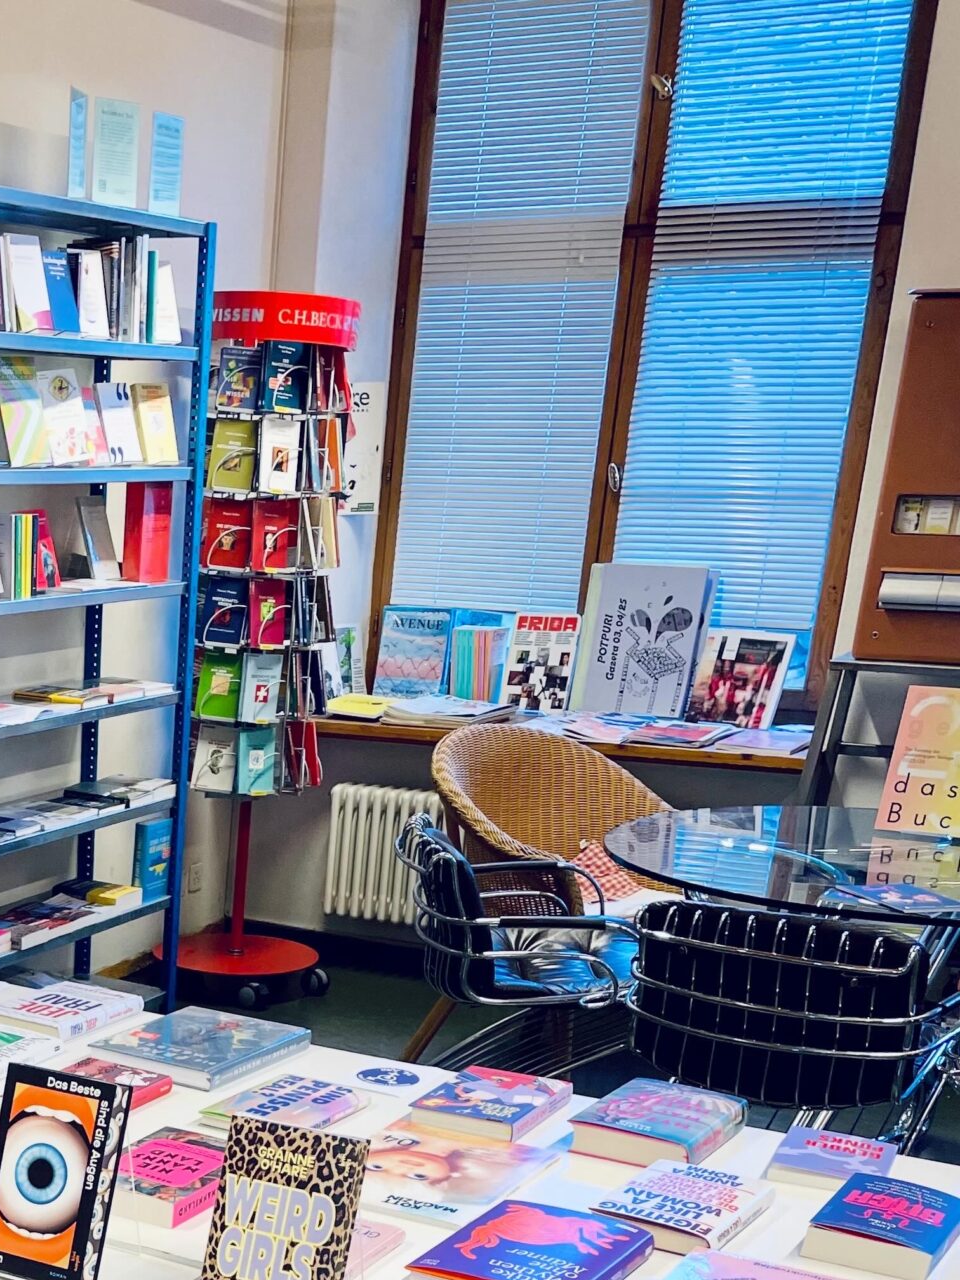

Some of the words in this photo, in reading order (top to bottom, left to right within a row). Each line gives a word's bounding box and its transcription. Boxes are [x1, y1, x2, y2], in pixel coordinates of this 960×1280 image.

[392, 616, 444, 632] AVENUE
[517, 614, 578, 632] FRIDA
[597, 613, 614, 664] POTPURI
[894, 772, 958, 798] das
[16, 1001, 81, 1018] JEDE
[34, 994, 103, 1012] FRAU
[47, 1076, 69, 1089] Das
[70, 1080, 102, 1098] Beste
[311, 1086, 354, 1105] SIND
[245, 1079, 334, 1117] PENISSE
[98, 1099, 110, 1128] sind
[94, 1127, 106, 1149] die
[819, 1134, 884, 1153] PUNKS
[804, 1139, 882, 1159] GENDER
[85, 1149, 103, 1191] Augen
[260, 1158, 308, 1179] O'HARE
[671, 1167, 744, 1188] ANDREA
[224, 1173, 336, 1246] WEIRD
[386, 1194, 458, 1214] MAGAZIN
[623, 1186, 723, 1218] WOMAN
[631, 1196, 648, 1205] A
[598, 1201, 712, 1236] FIGHTING
[653, 1203, 704, 1220] LIKE
[505, 1248, 588, 1274] Männer
[528, 1259, 579, 1280] ohne
